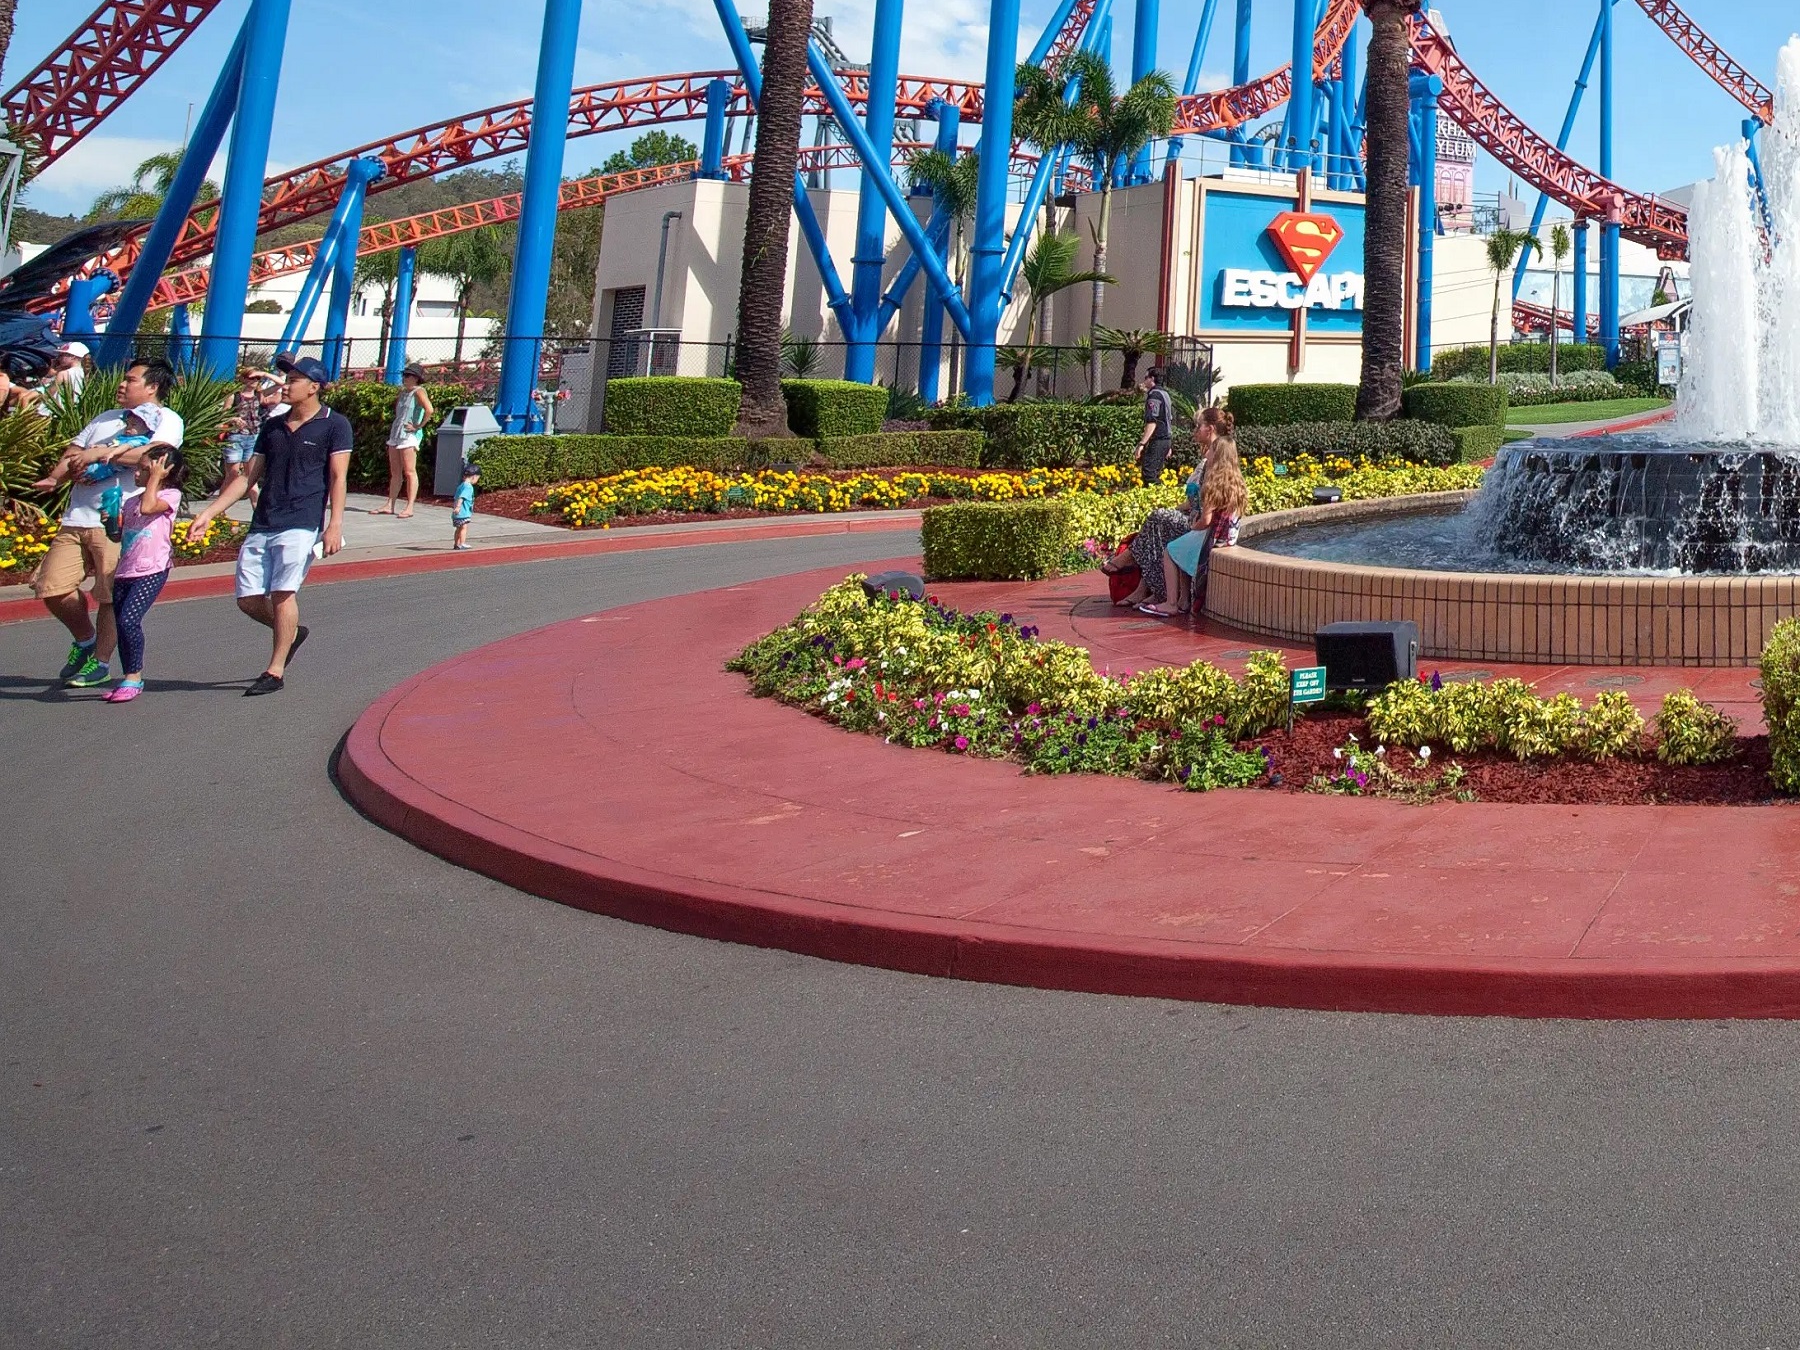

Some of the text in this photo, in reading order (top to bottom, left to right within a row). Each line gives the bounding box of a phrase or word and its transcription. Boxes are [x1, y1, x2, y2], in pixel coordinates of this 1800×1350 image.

[1437, 120, 1467, 139] KHA
[1436, 139, 1477, 157] YLUM
[1295, 679, 1319, 688] KEEP OFF
